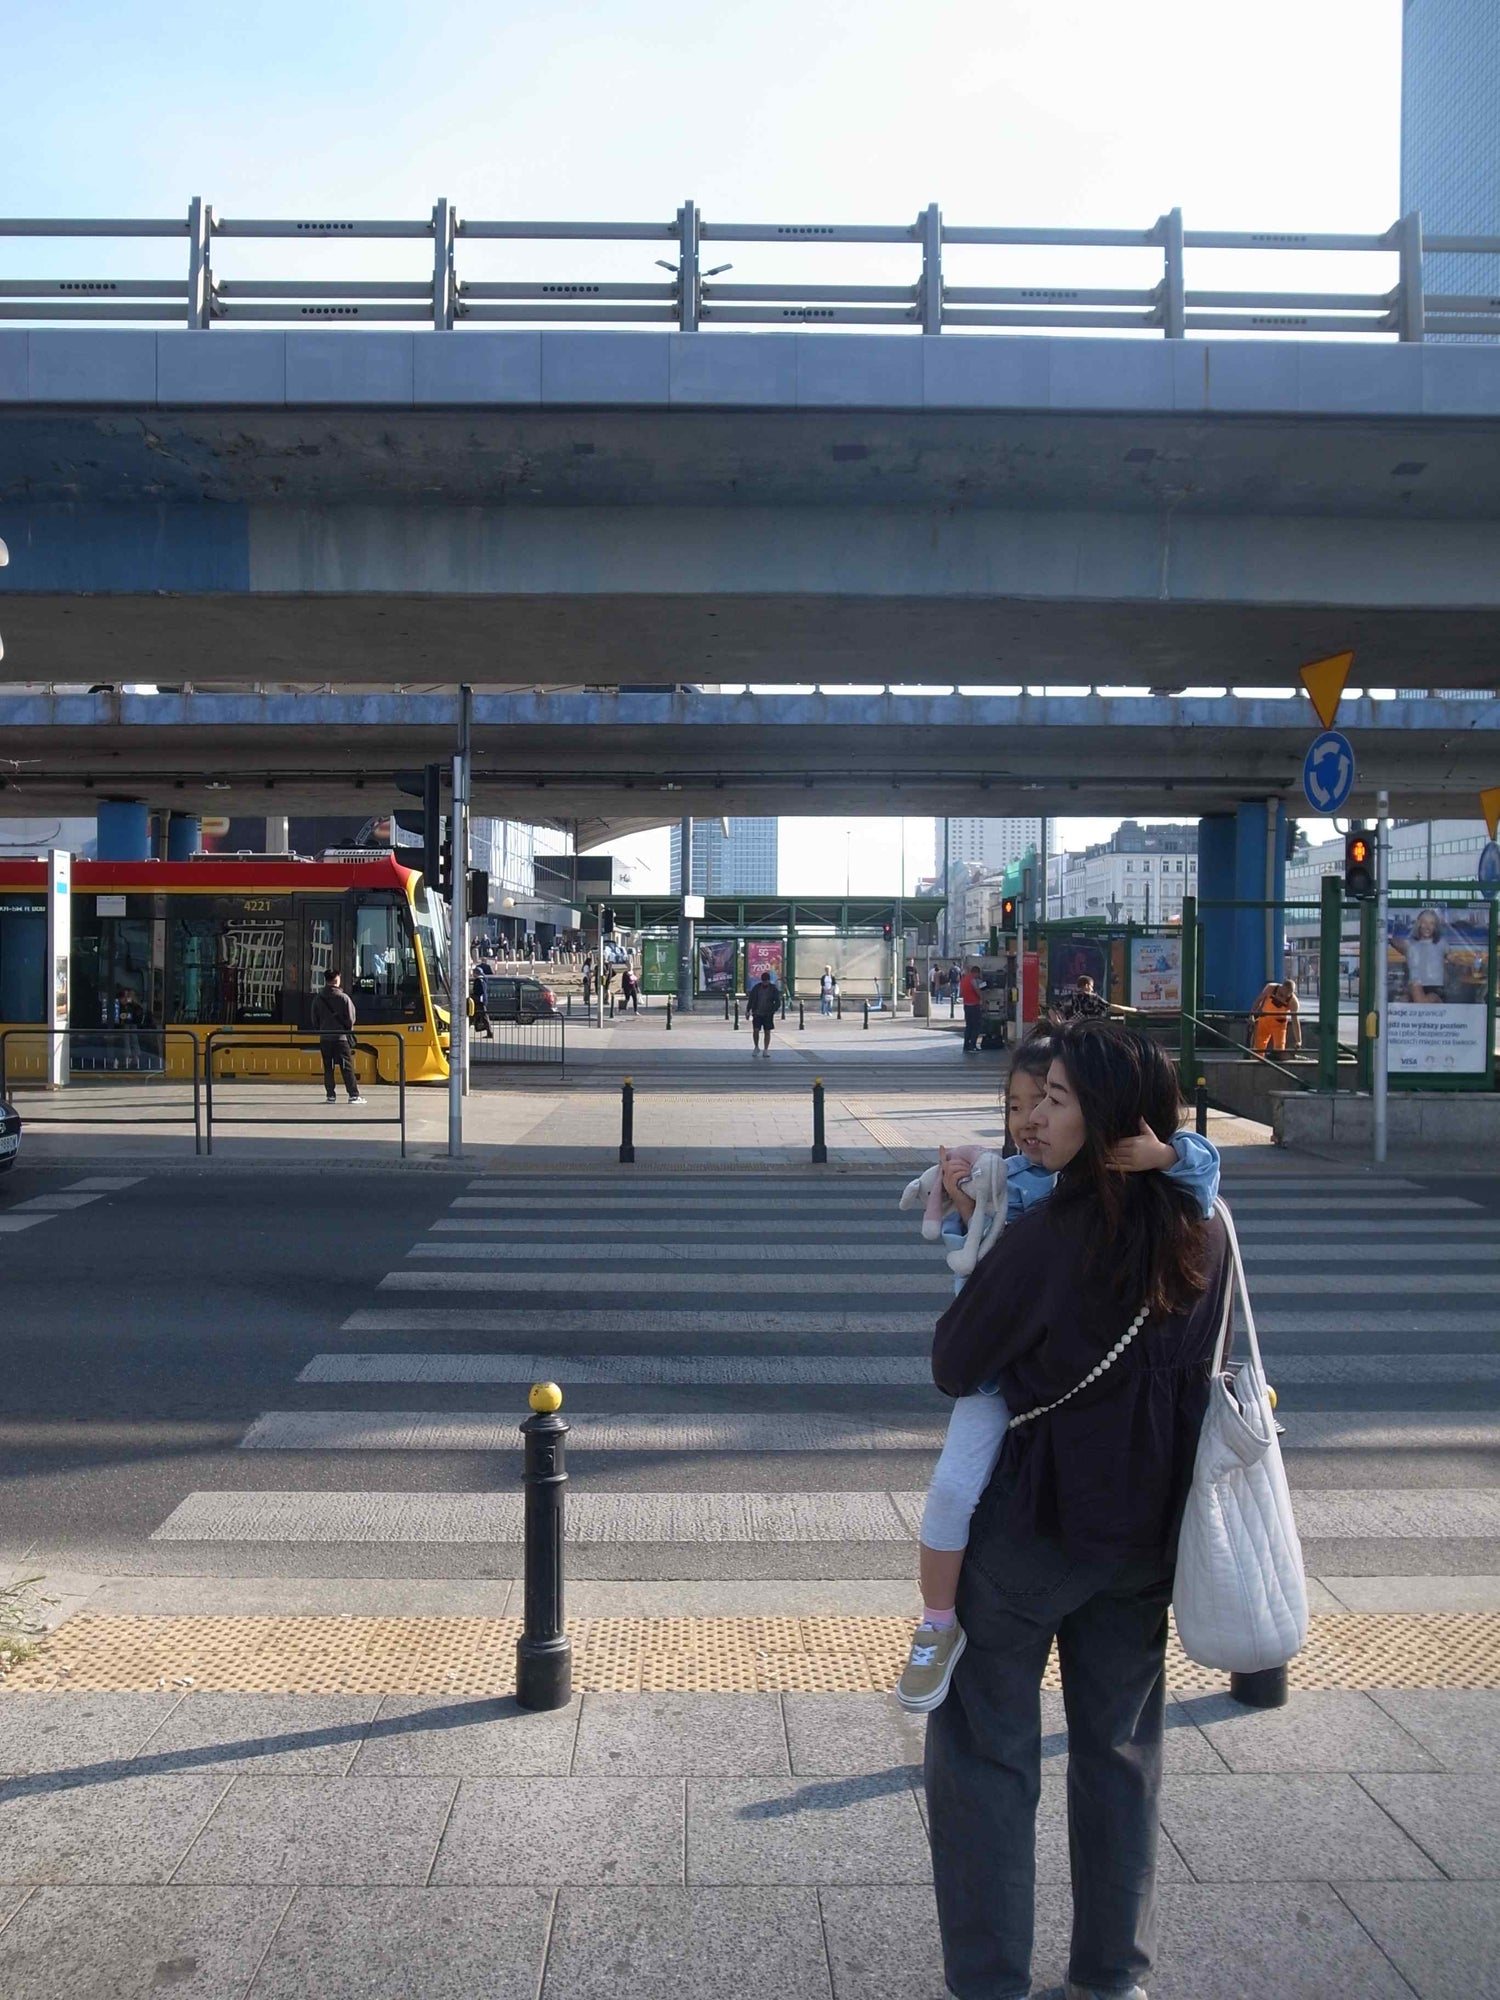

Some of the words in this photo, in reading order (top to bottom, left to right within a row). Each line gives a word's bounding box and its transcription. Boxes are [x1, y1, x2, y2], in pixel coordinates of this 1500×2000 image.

[244, 900, 270, 911] 4221
[758, 948, 769, 957] 5G
[1411, 1022, 1439, 1030] wyższy
[1440, 1022, 1468, 1030] poziom
[1401, 1057, 1418, 1065] VISA
